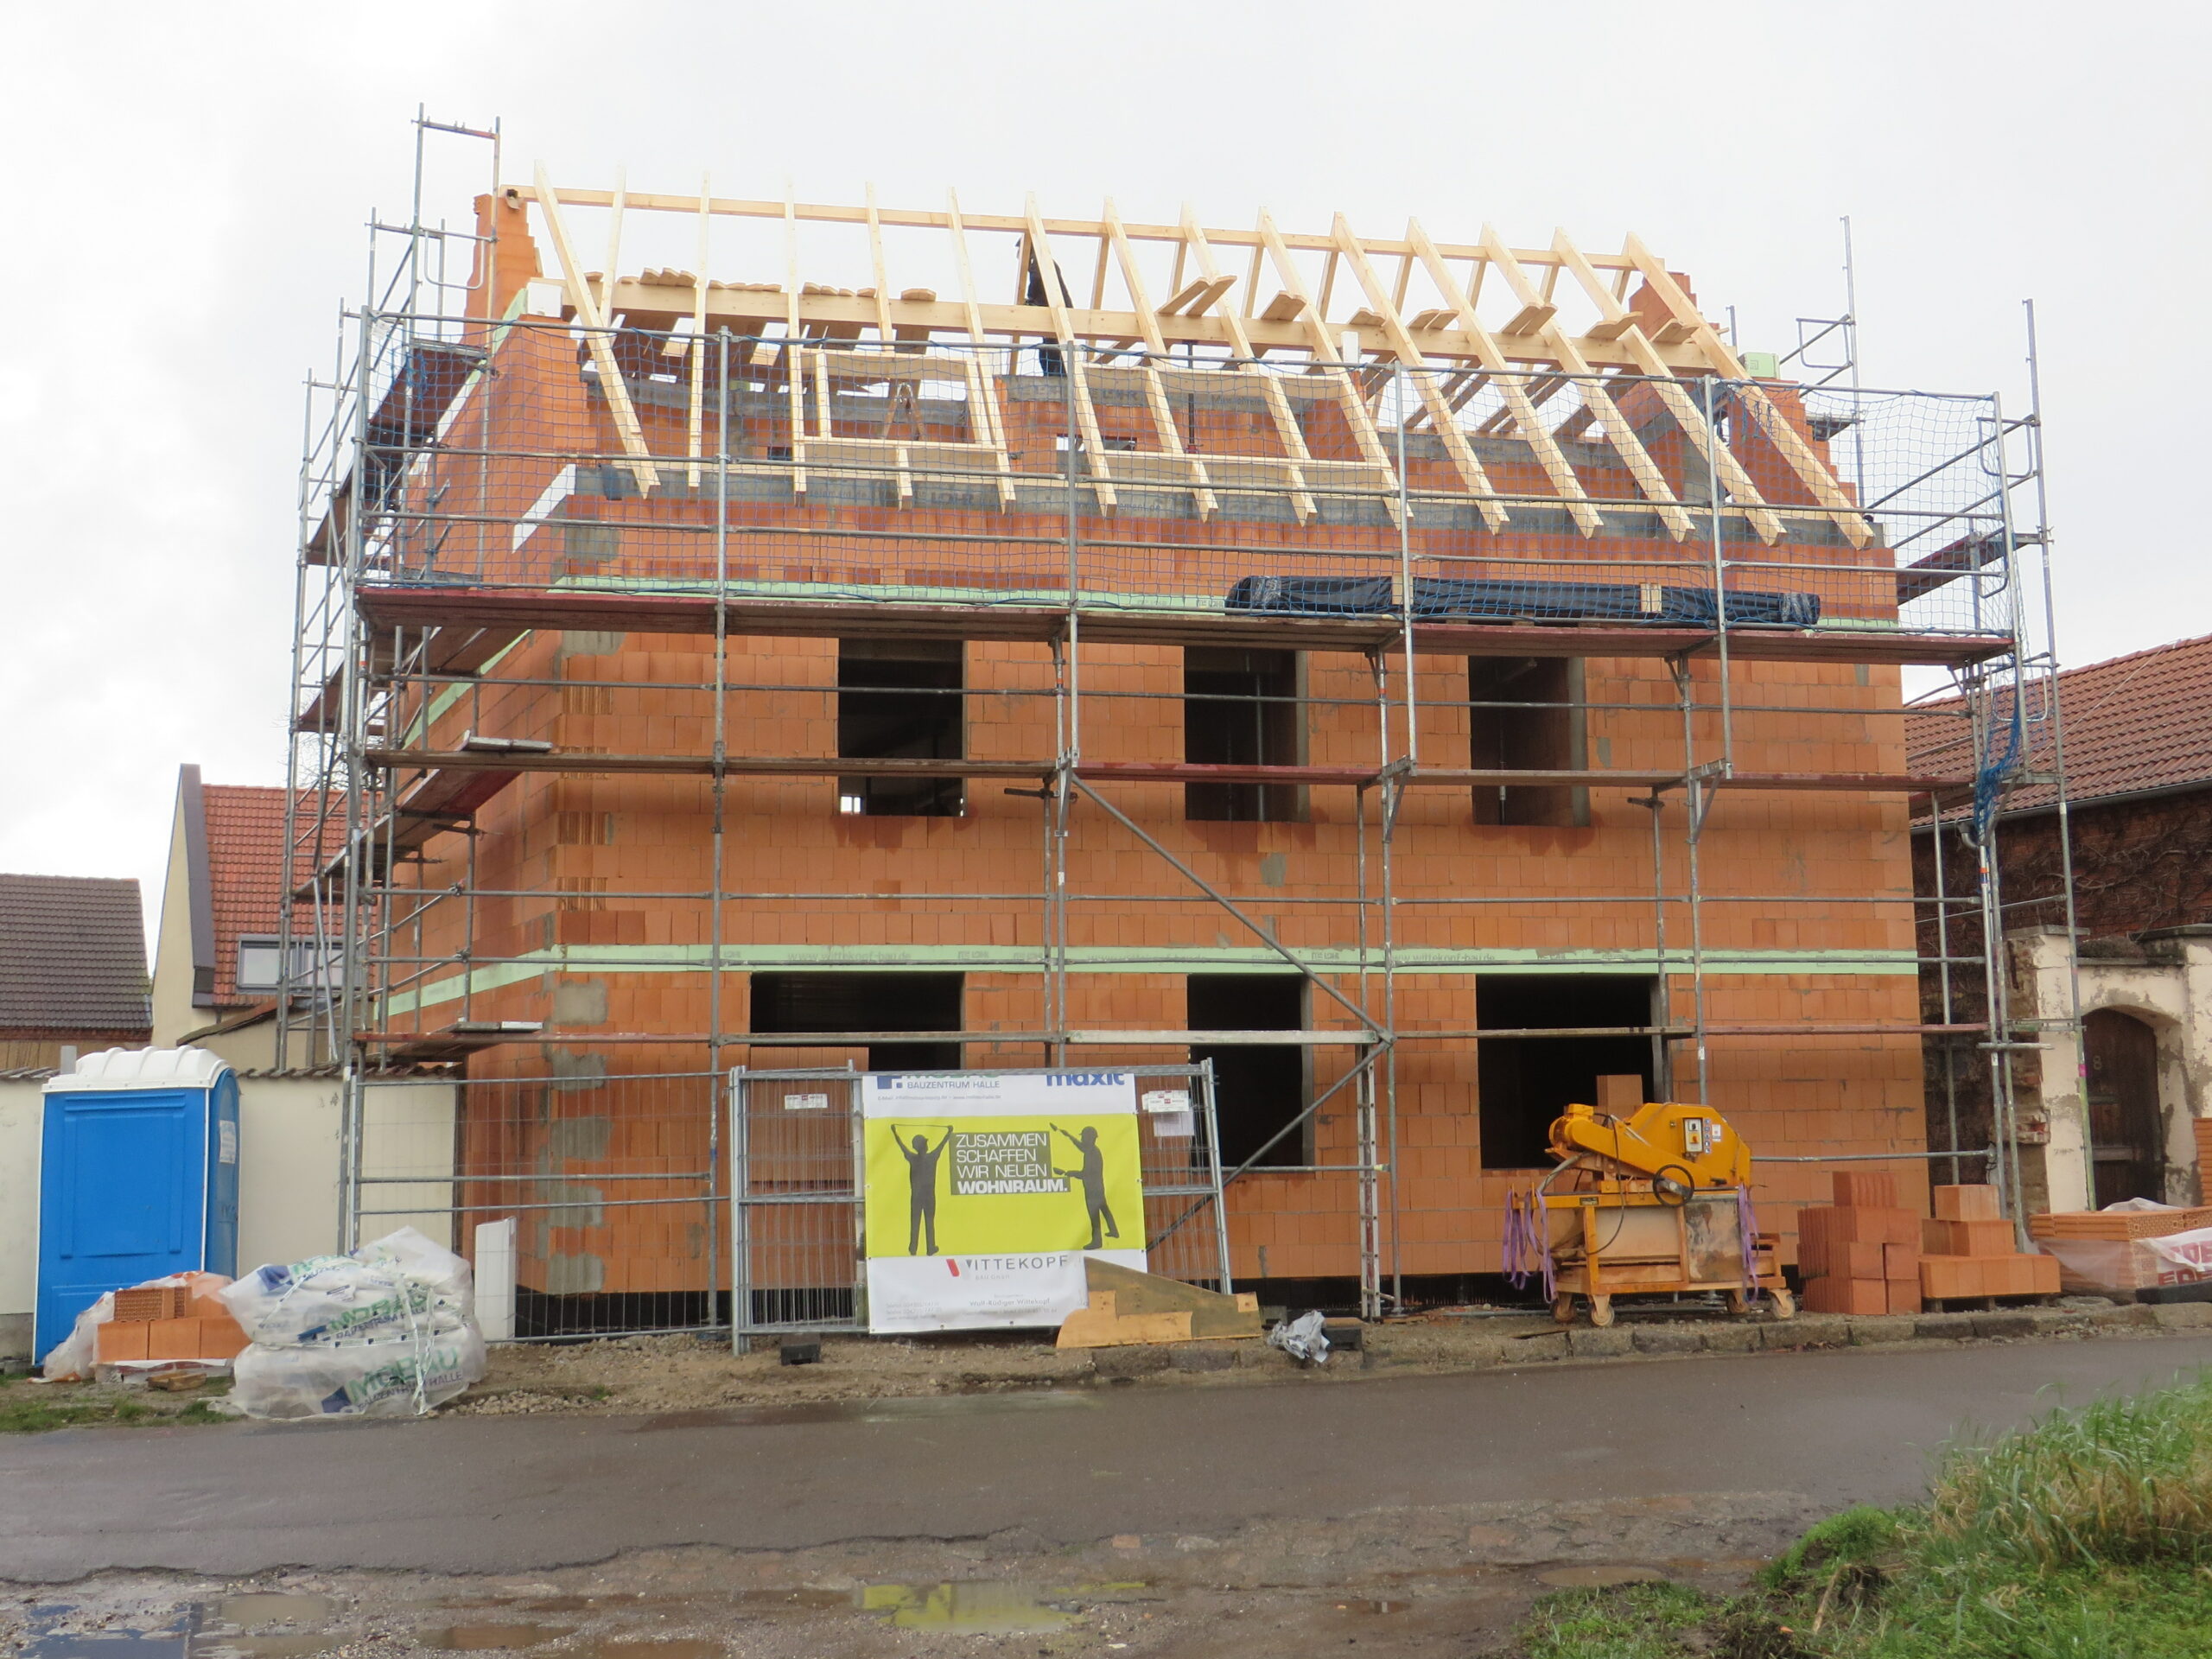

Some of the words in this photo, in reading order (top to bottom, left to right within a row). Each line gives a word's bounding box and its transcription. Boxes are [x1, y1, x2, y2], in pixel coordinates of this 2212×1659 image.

[973, 1080, 1001, 1089] HALLE
[956, 1133, 1047, 1147] ZUSAMMEN
[956, 1148, 1037, 1163] SCHAFFEN
[957, 1165, 989, 1179] WIR
[995, 1163, 1047, 1178] NEUEN
[957, 1179, 1068, 1194] WOHNRAUM.
